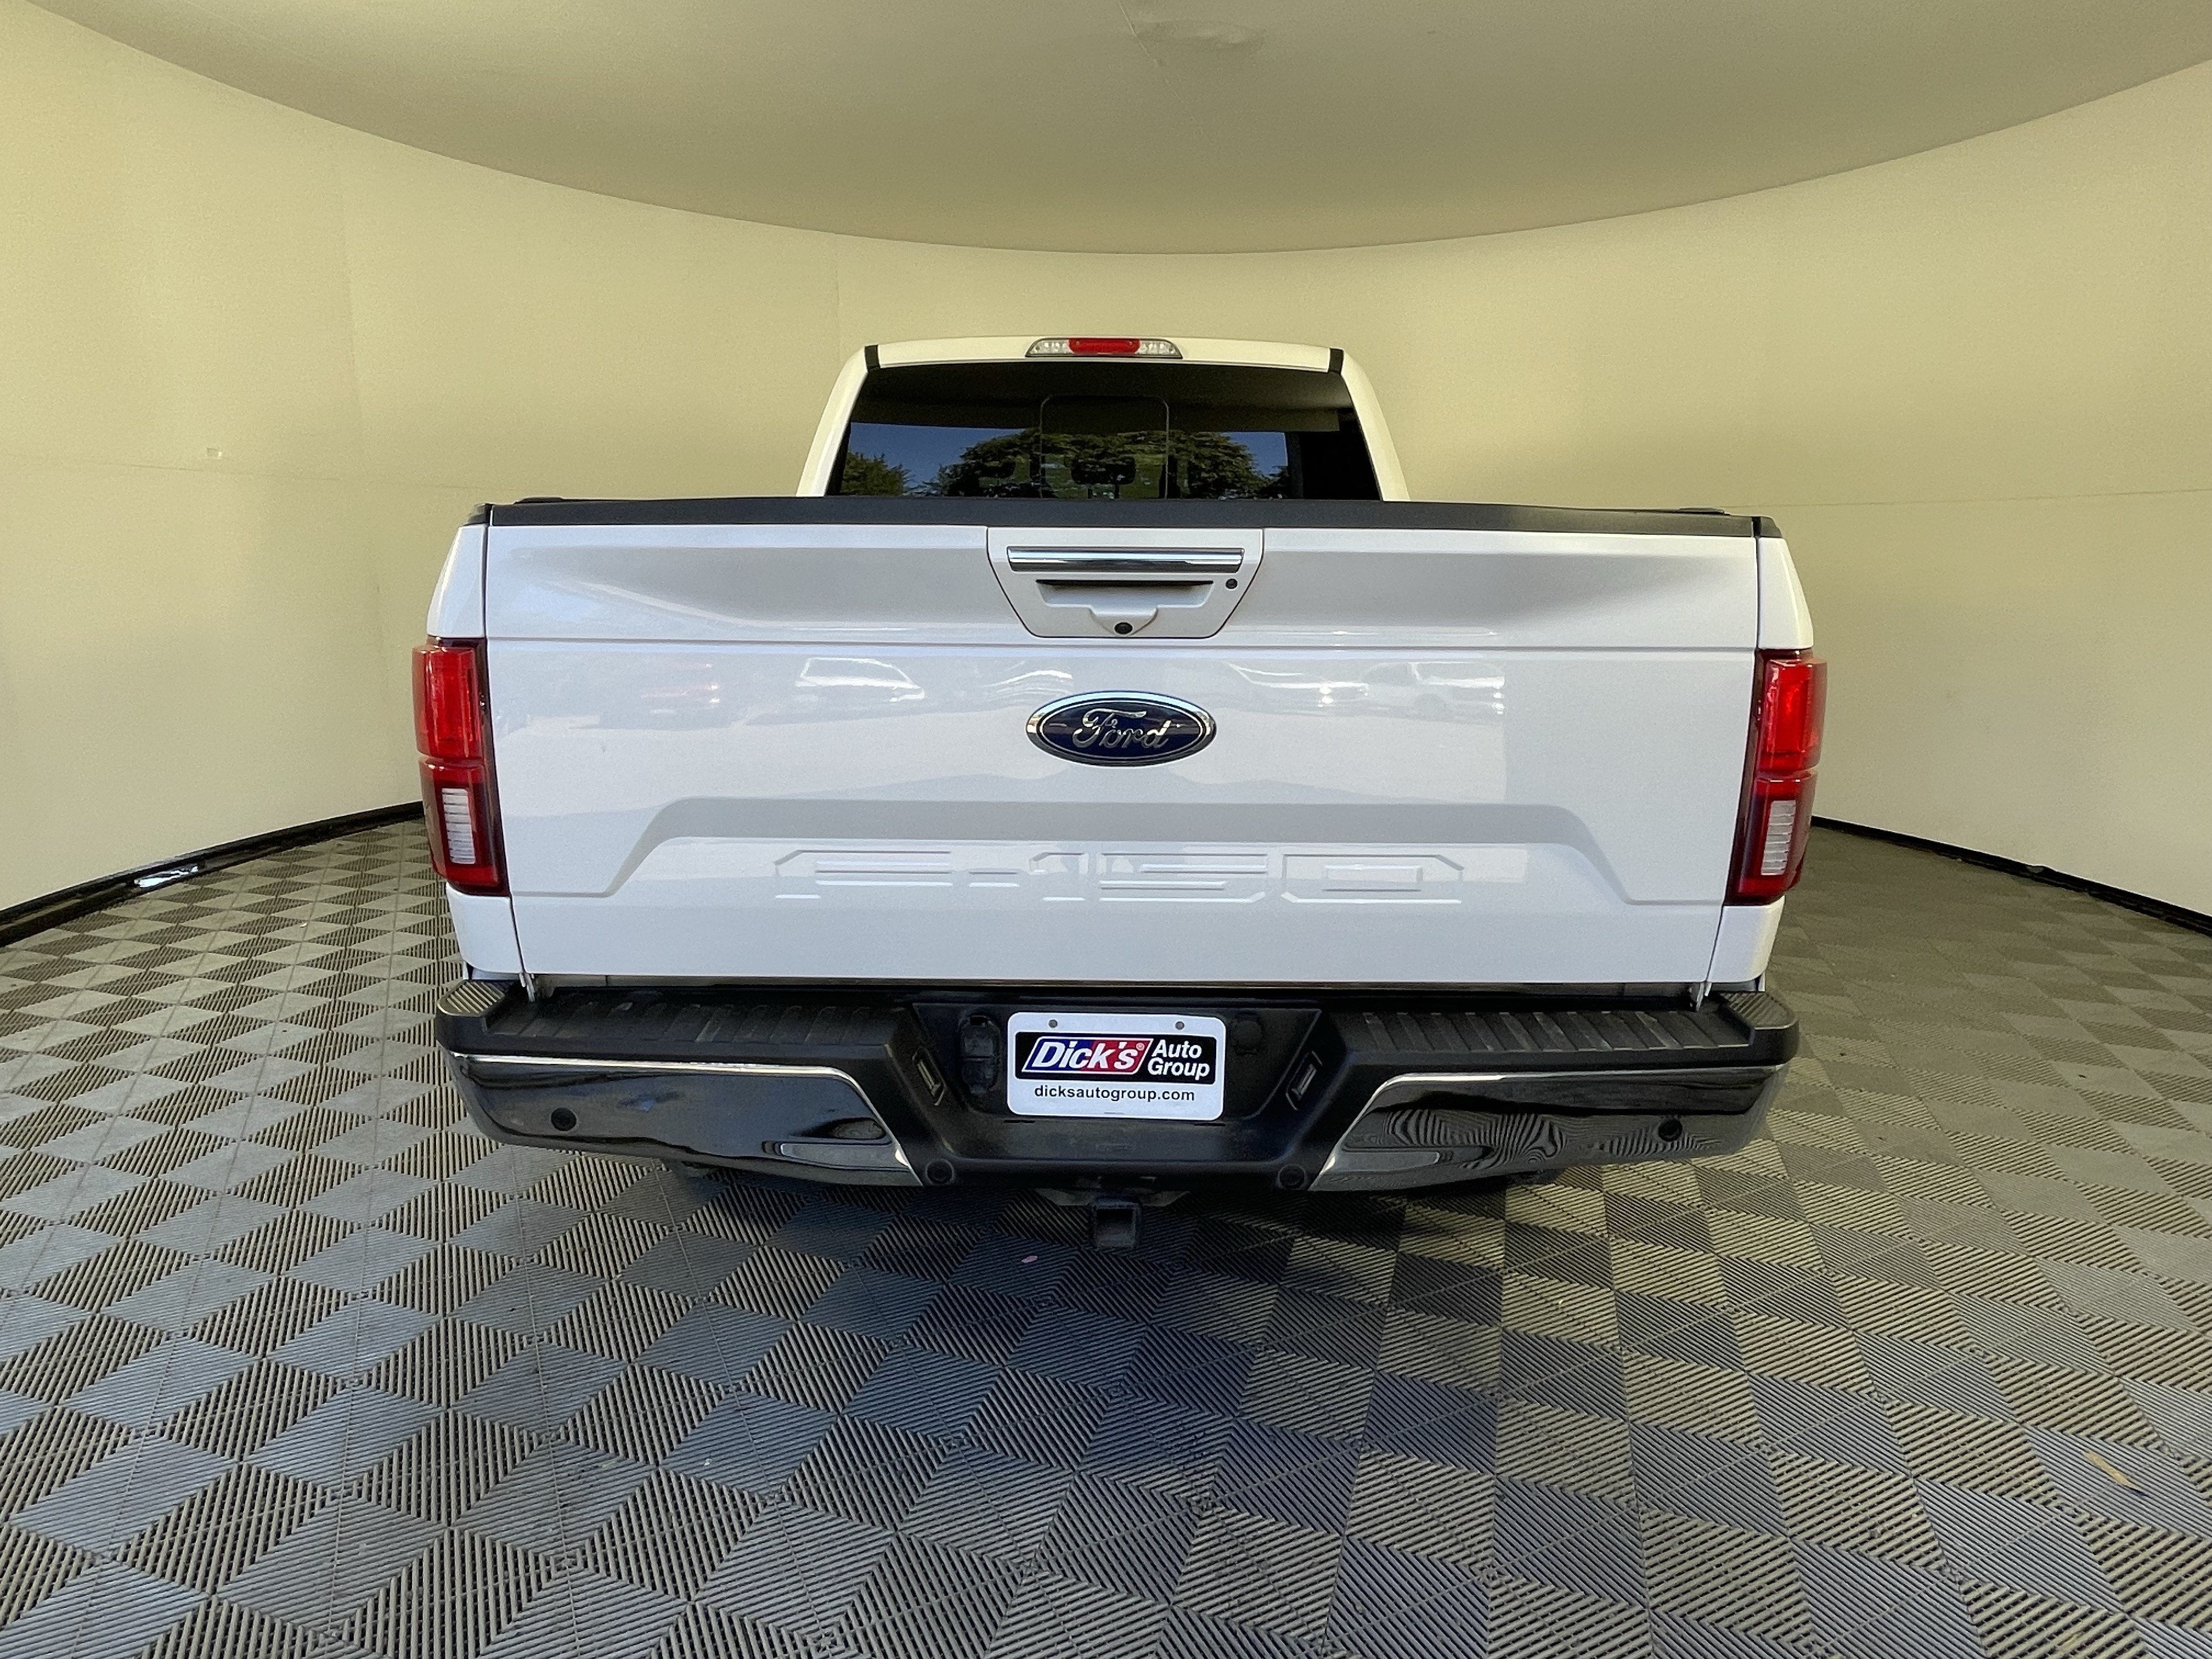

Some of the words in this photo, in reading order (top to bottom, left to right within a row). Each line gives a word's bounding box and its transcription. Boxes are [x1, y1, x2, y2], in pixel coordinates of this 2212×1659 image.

[1071, 707, 1172, 749] Ford
[773, 848, 1466, 904] F-150
[1151, 1039, 1203, 1059] Auto
[1147, 1057, 1210, 1081] Group
[1034, 1085, 1195, 1102] dicksautogroup.com
